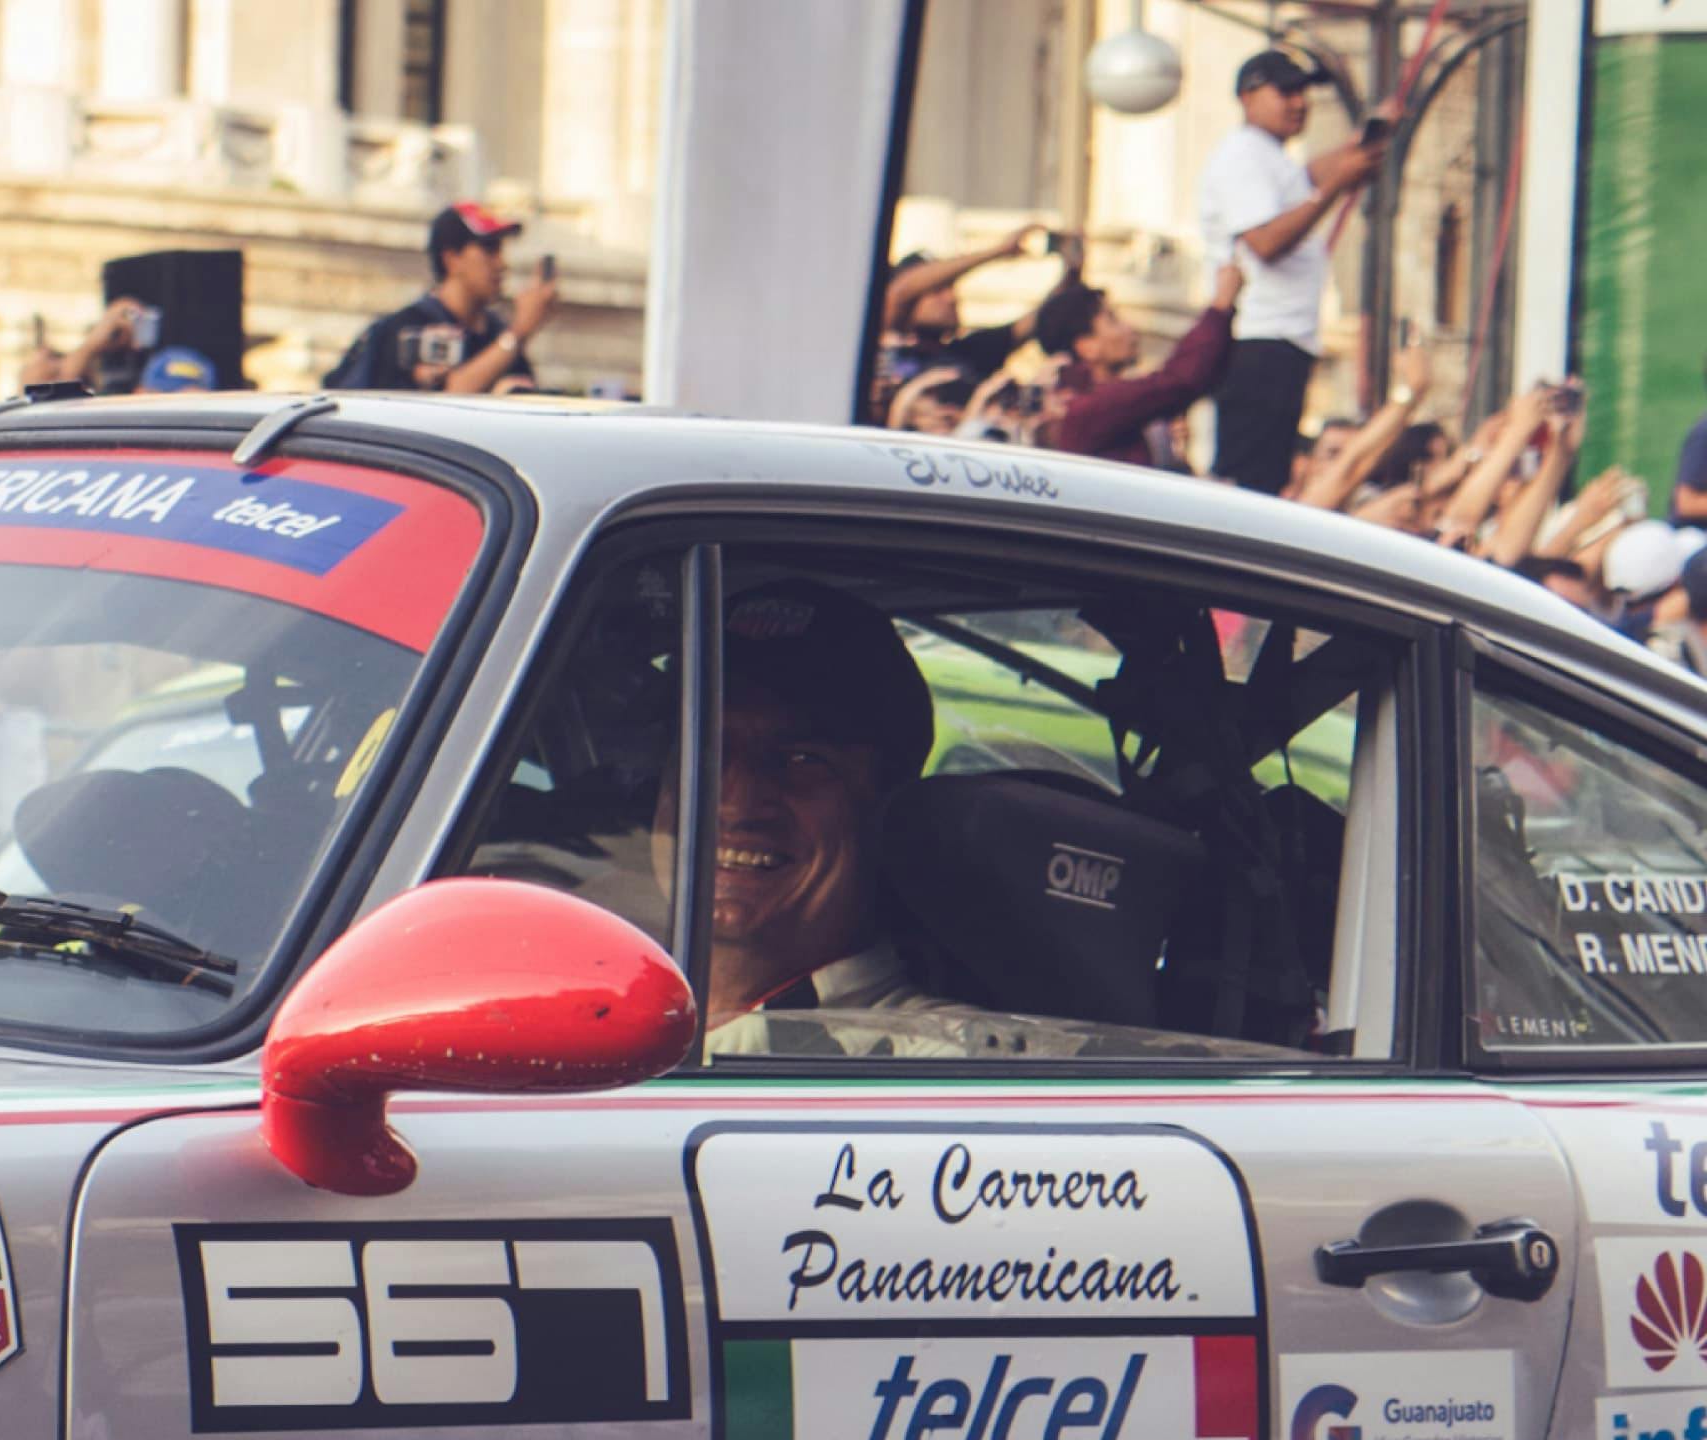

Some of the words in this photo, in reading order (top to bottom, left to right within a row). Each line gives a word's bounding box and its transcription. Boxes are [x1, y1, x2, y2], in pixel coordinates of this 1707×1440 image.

[212, 494, 340, 539] telcel
[1048, 852, 1120, 899] OMP
[1557, 872, 1600, 912] D.
[1602, 872, 1707, 914] CAND
[1575, 933, 1619, 974] R.
[814, 1143, 904, 1211] La
[932, 1143, 1148, 1224] Carrera
[199, 1241, 669, 1406] 567
[1384, 1398, 1495, 1428] Guanajuato
